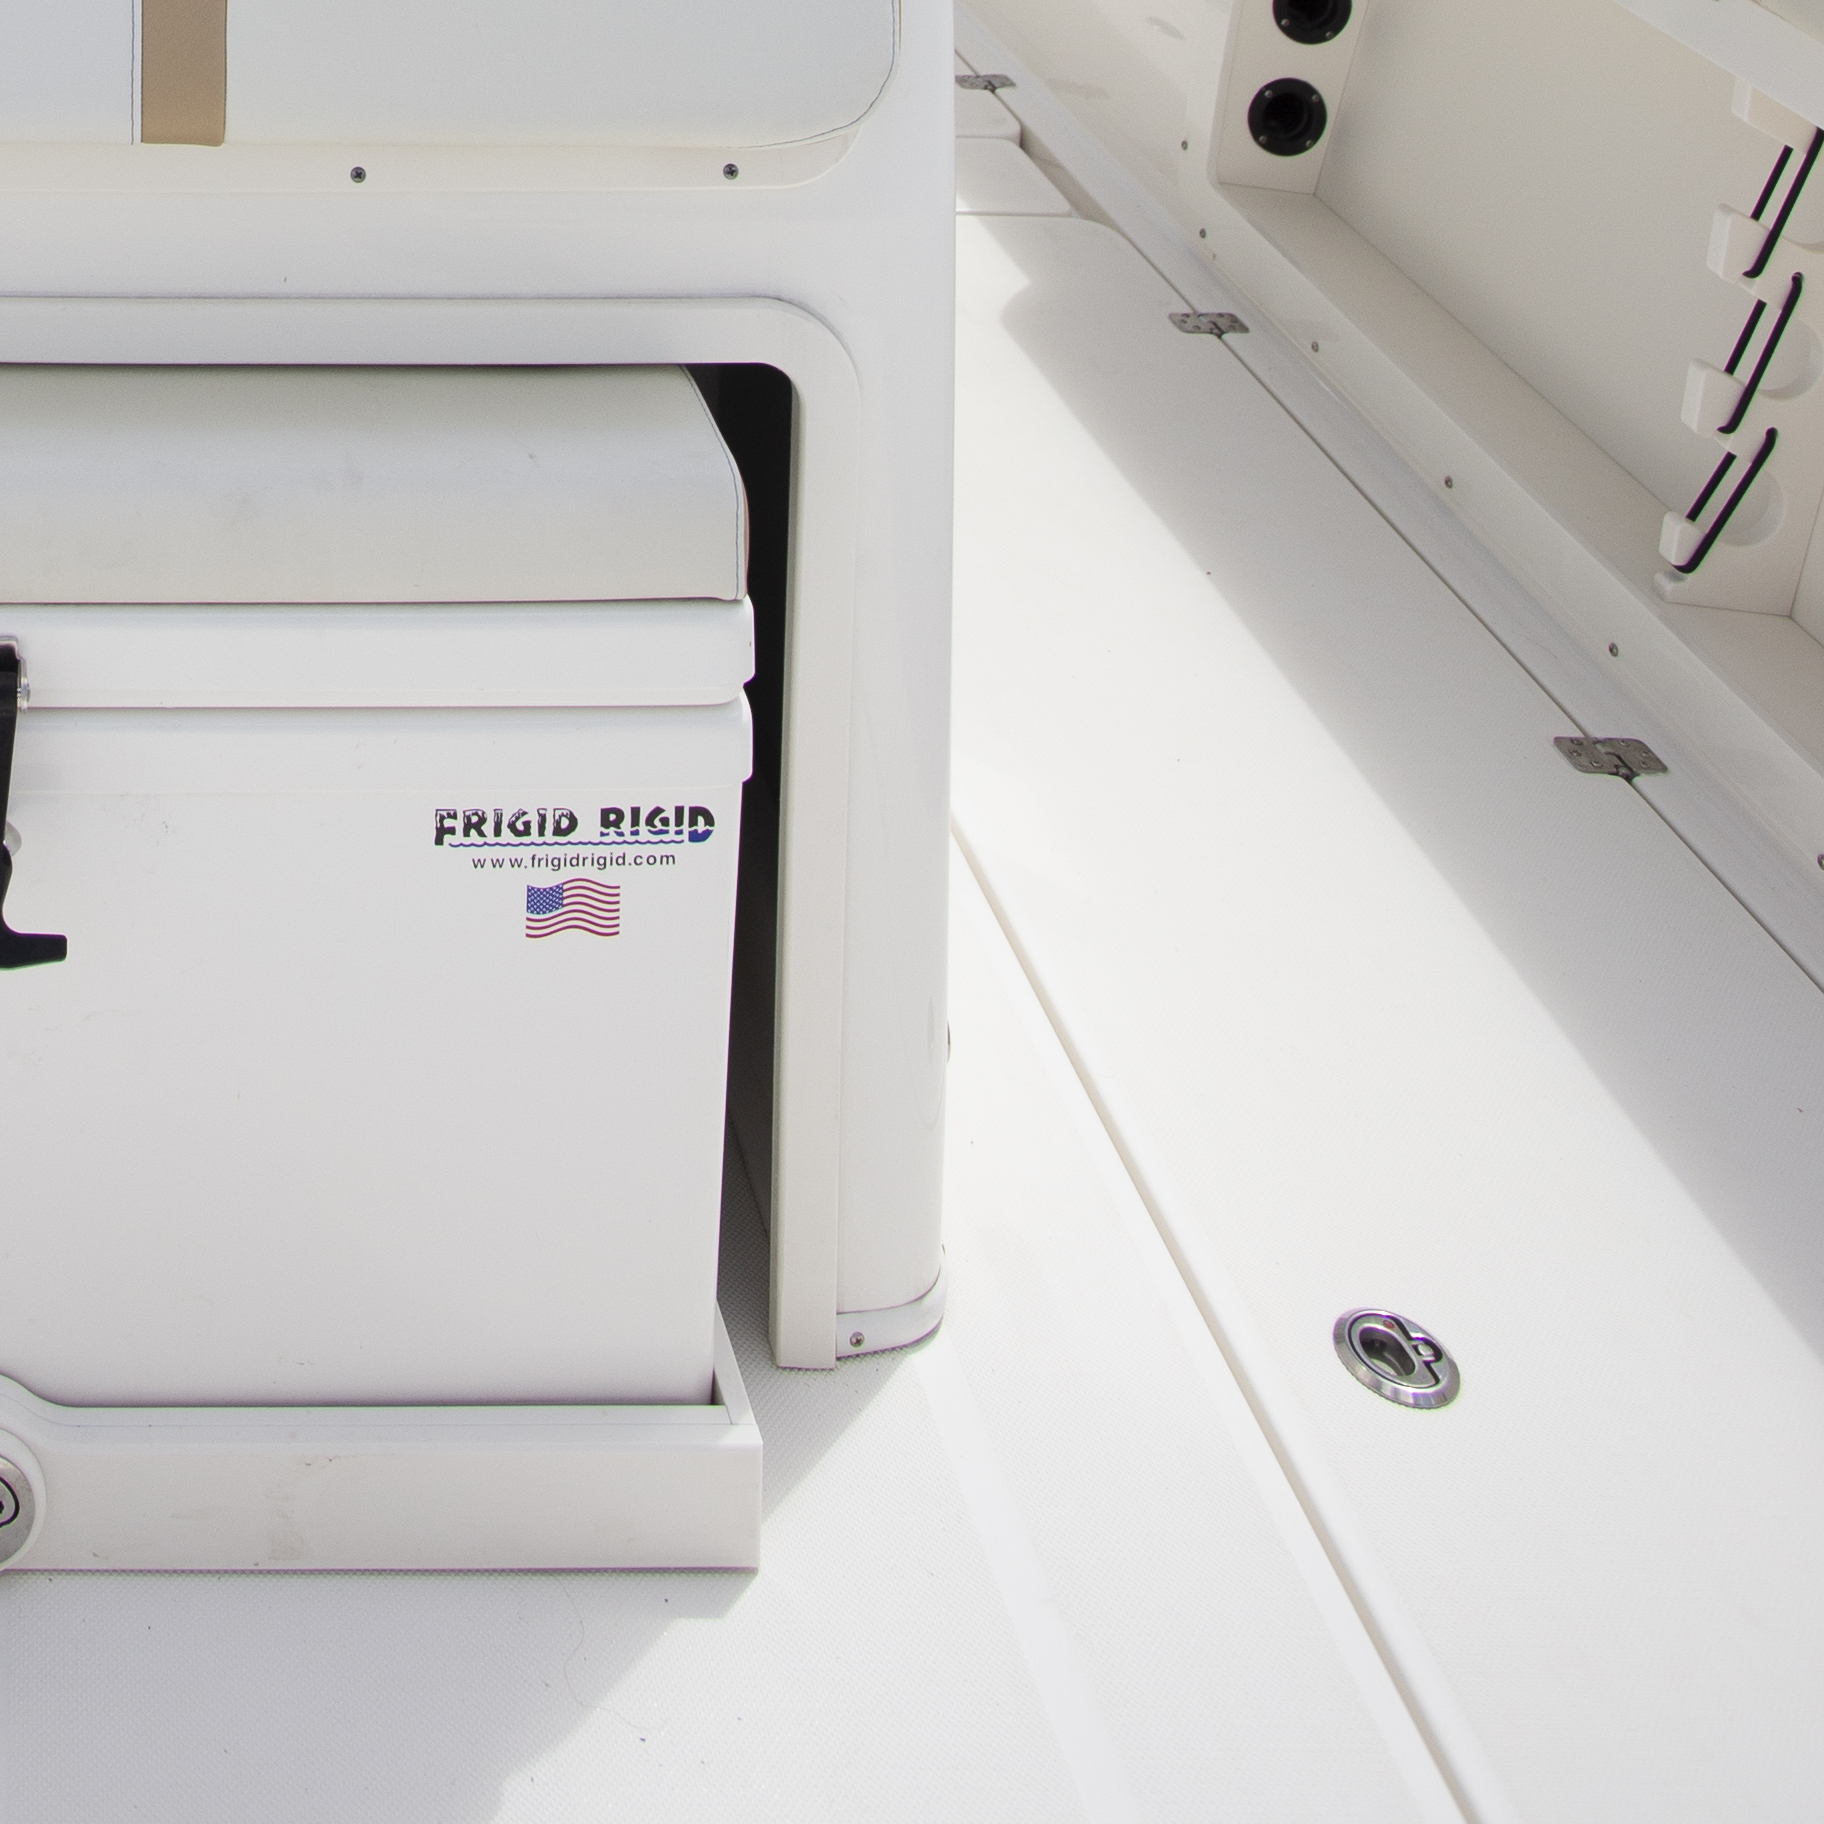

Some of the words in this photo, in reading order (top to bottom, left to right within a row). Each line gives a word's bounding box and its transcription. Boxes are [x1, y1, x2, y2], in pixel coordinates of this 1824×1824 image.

[434, 807, 579, 846] FRIGID
[600, 805, 716, 843] RIGID
[471, 852, 677, 871] www.frigidrigid.com
